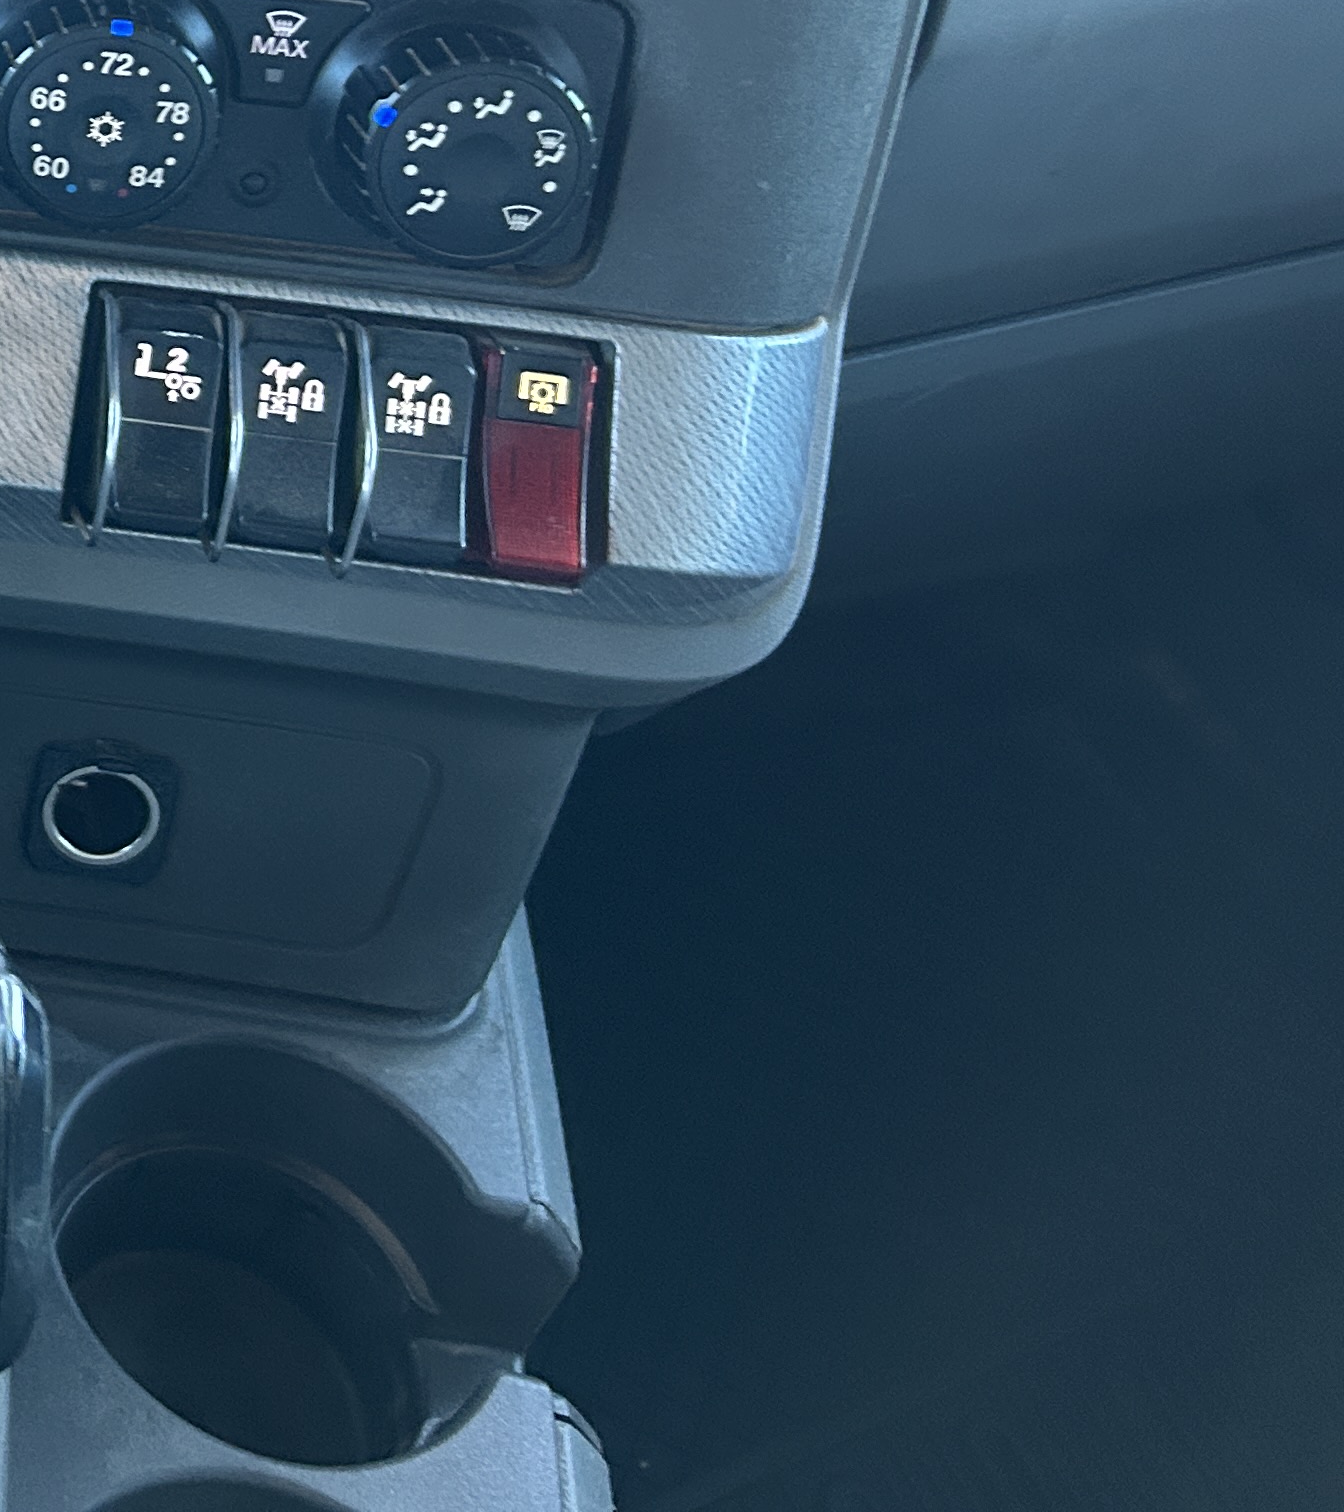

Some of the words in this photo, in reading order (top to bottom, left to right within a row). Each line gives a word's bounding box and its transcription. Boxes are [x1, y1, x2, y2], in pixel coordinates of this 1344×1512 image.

[249, 34, 311, 60] MAX
[99, 50, 136, 77] 72
[29, 86, 68, 112] 66
[154, 100, 191, 125] 78
[32, 154, 71, 180] 60
[127, 164, 166, 189] 84
